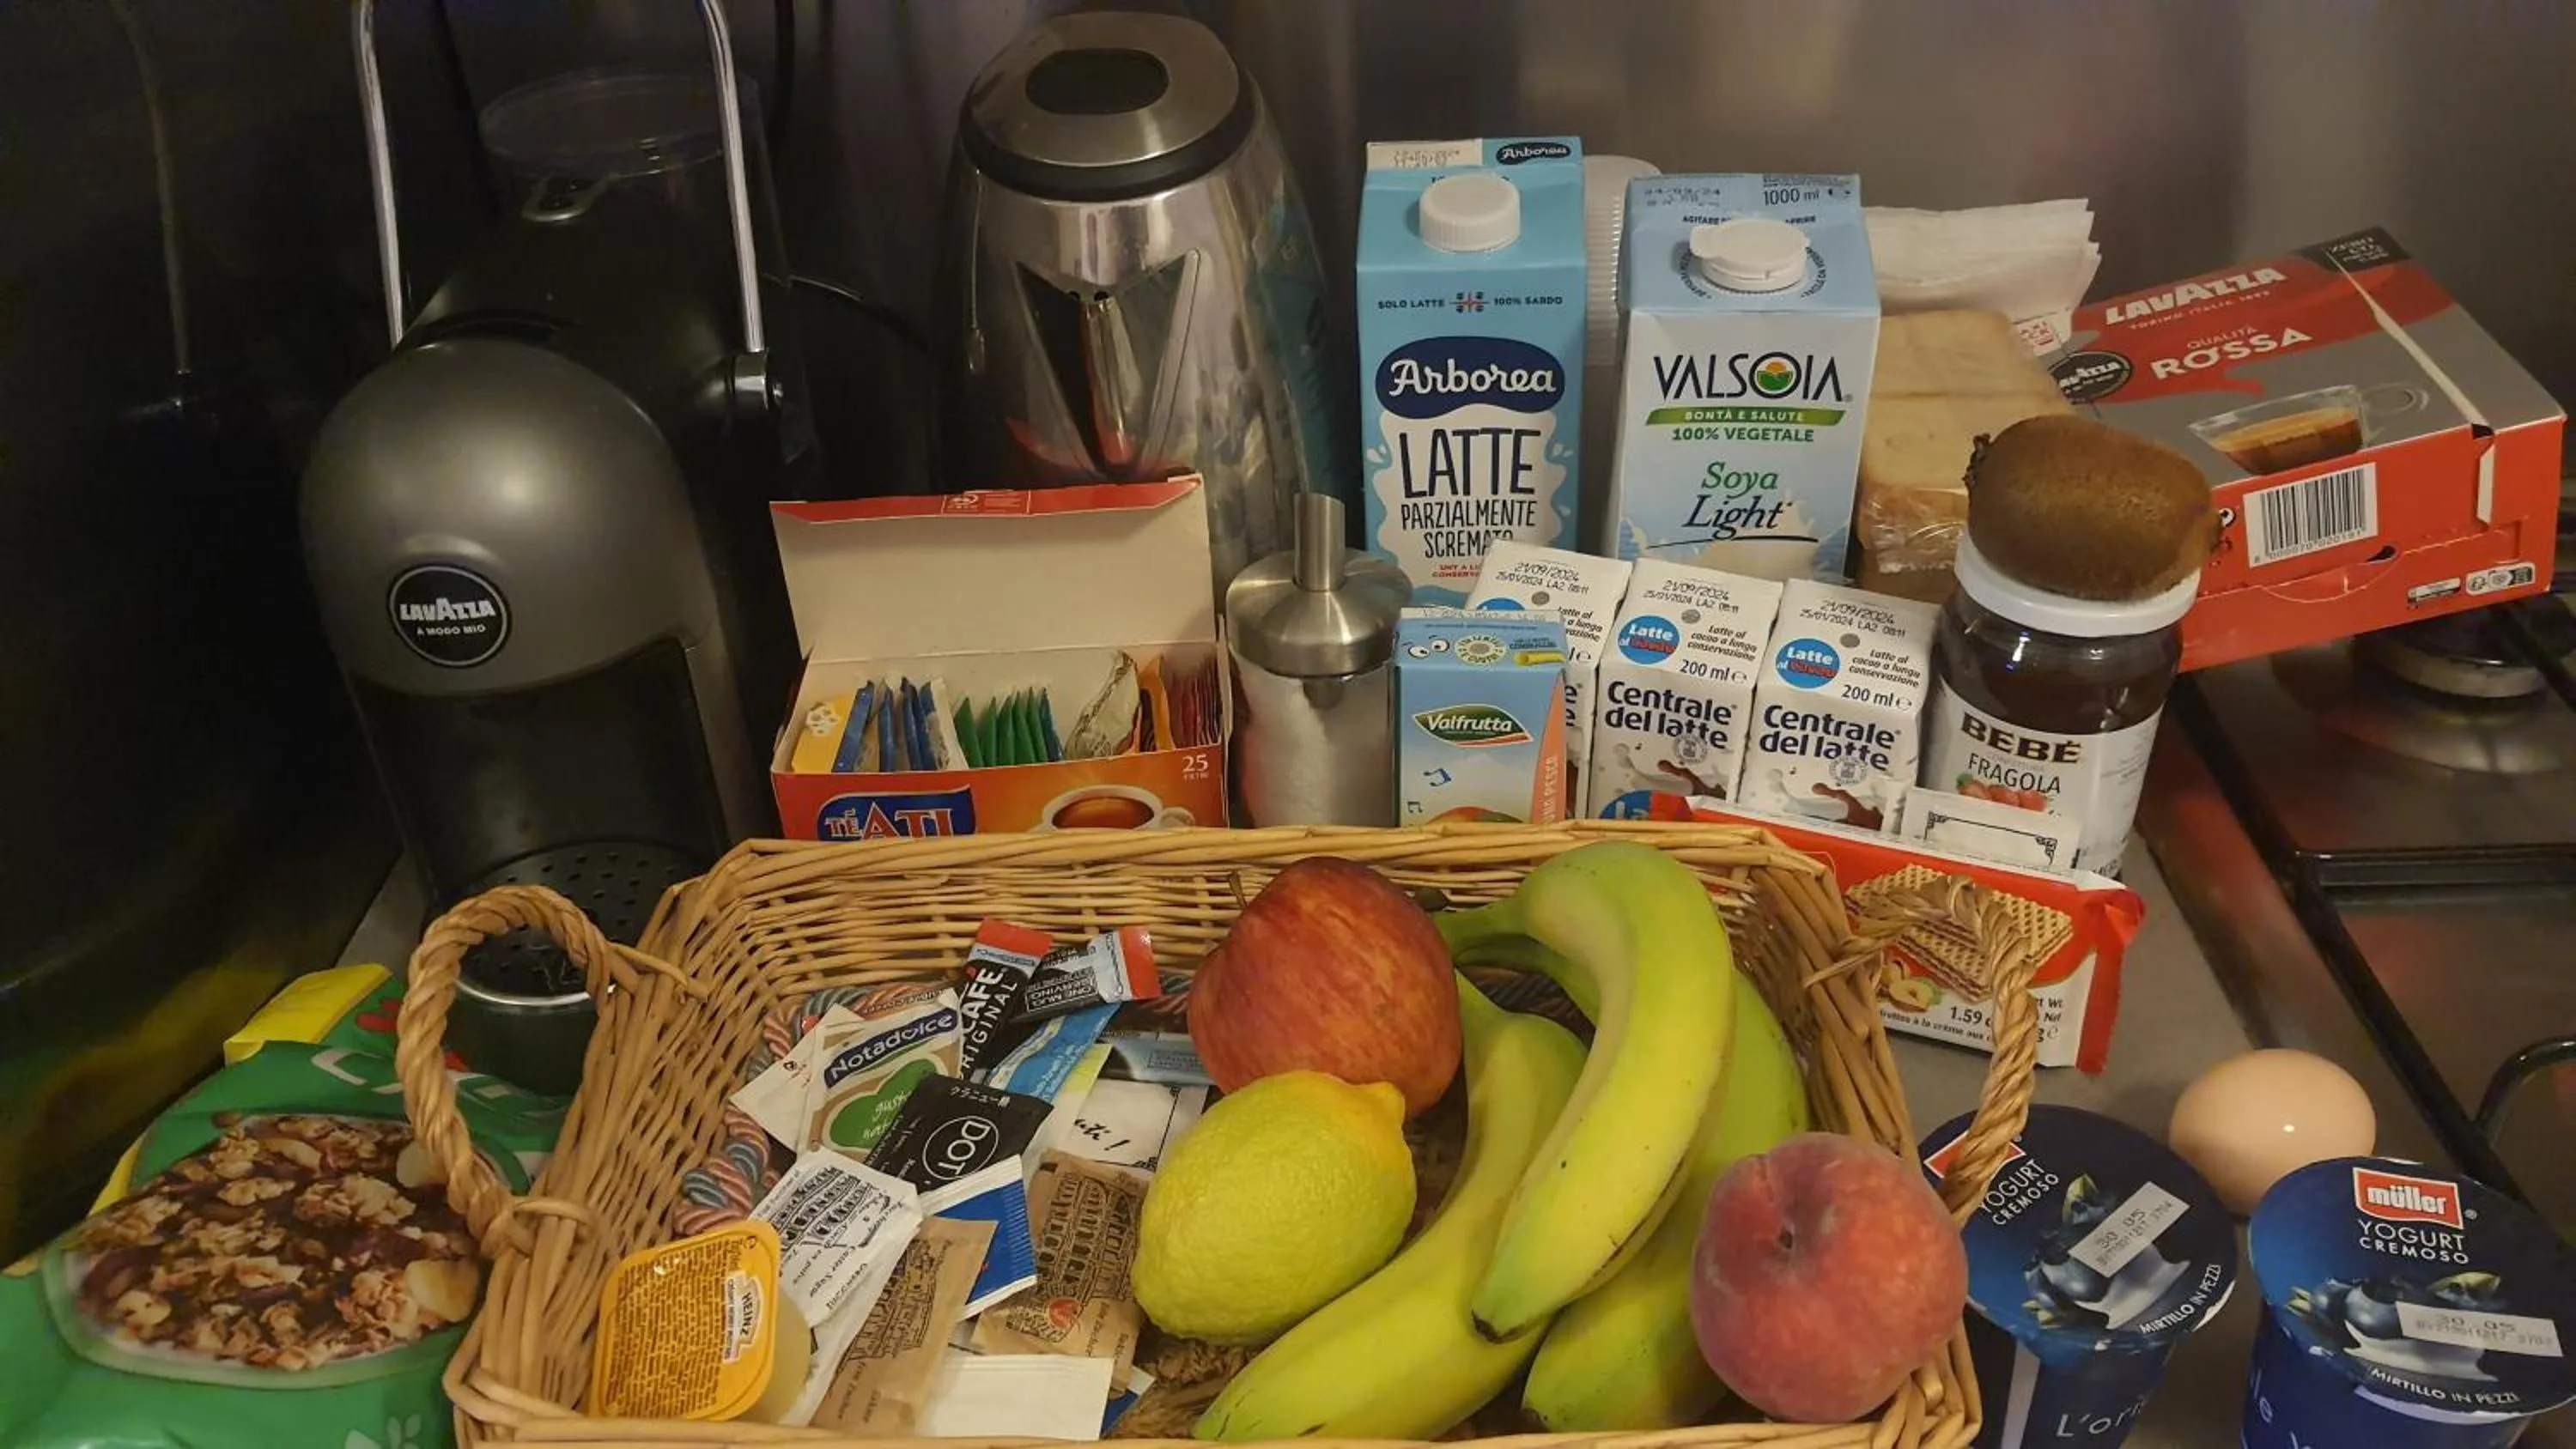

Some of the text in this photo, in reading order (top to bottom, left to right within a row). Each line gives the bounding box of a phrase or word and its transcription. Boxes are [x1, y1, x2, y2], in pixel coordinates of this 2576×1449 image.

[1762, 188, 1801, 206] 1000
[1377, 294, 1564, 310] SOLO LATTE 100% SARDO
[2105, 266, 2288, 326] LAVAZZA
[2149, 326, 2313, 381] ROSSA
[1388, 357, 1557, 397] Arborea
[1653, 350, 1844, 403] VALSOIA
[2059, 361, 2122, 389] AVAZZA
[1684, 408, 1732, 421] BONTÀ
[1750, 410, 1805, 421] SALUTE
[1671, 427, 1815, 442] 100% VEGETALE
[1399, 427, 1541, 499] LATTE
[1700, 460, 1780, 500] Soya
[1400, 499, 1538, 531] PARZIALMENTE
[1681, 494, 1785, 541] Light
[1424, 529, 1515, 559] SCREMA
[399, 597, 497, 622] LAVAZZA
[463, 623, 487, 635] MIO
[1628, 621, 1674, 642] Latte
[1708, 624, 1735, 638] Latte
[1686, 641, 1757, 663] conservazione
[1728, 638, 1758, 654] lunga
[1786, 646, 1834, 666] Latte
[1868, 648, 1911, 664] Latte al
[1679, 658, 1731, 682] 200 ml
[1848, 665, 1921, 688] conservazione
[1851, 656, 1882, 669] cacao
[1891, 663, 1922, 680] lunga
[1607, 680, 1733, 726] Centrale
[1841, 684, 1896, 708] 200 ml
[1425, 712, 1513, 733] Valfrutta
[1604, 706, 1652, 732] del
[1656, 712, 1728, 750] latte
[1763, 704, 1896, 750] Centrale
[1182, 754, 1210, 773] 25
[1759, 730, 1810, 757] del
[1813, 735, 1891, 773] latte
[1967, 752, 2062, 795] FRAGOLA
[960, 980, 1019, 1073] RIGINAL
[1949, 1004, 1984, 1026] 1.59
[830, 1014, 954, 1080] Notadolce
[937, 1119, 992, 1176] DOT
[1978, 1158, 2047, 1215] YOGURT
[1992, 1173, 2061, 1226] CREMOSO
[2366, 1183, 2447, 1216] müller
[2358, 1218, 2466, 1252] YOGURT
[2359, 1236, 2470, 1265] CREMOSO
[740, 1291, 756, 1337] HEINZ
[2138, 1262, 2223, 1336] MIRTILLO IN PEZZI
[2370, 1367, 2521, 1404] MIRTILLO IN PEZZI
